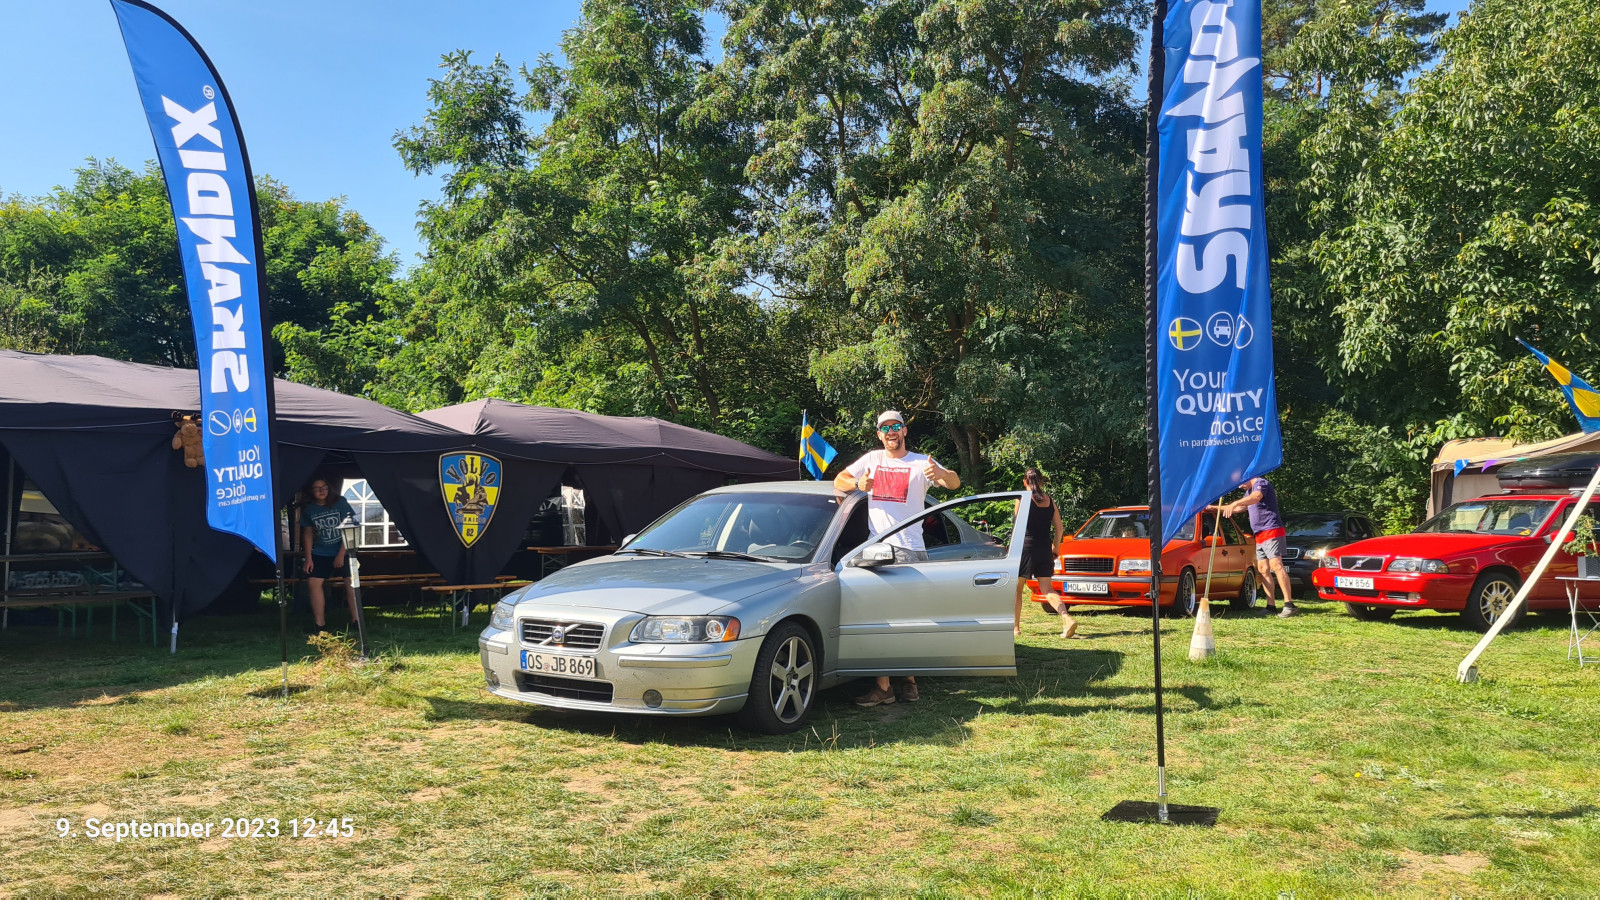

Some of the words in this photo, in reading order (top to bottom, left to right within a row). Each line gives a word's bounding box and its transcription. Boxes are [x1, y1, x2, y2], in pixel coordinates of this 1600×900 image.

[1164, 0, 1260, 294] SKAND
[1175, 388, 1264, 416] QUALITY
[1179, 439, 1189, 447] in
[445, 456, 497, 485] VOLVO
[465, 528, 475, 537] 82
[1086, 583, 1091, 591] V
[1092, 583, 1107, 592] 850
[1355, 578, 1370, 588] 856
[527, 653, 543, 670] OS
[551, 656, 567, 673] JB
[569, 658, 593, 676] 869
